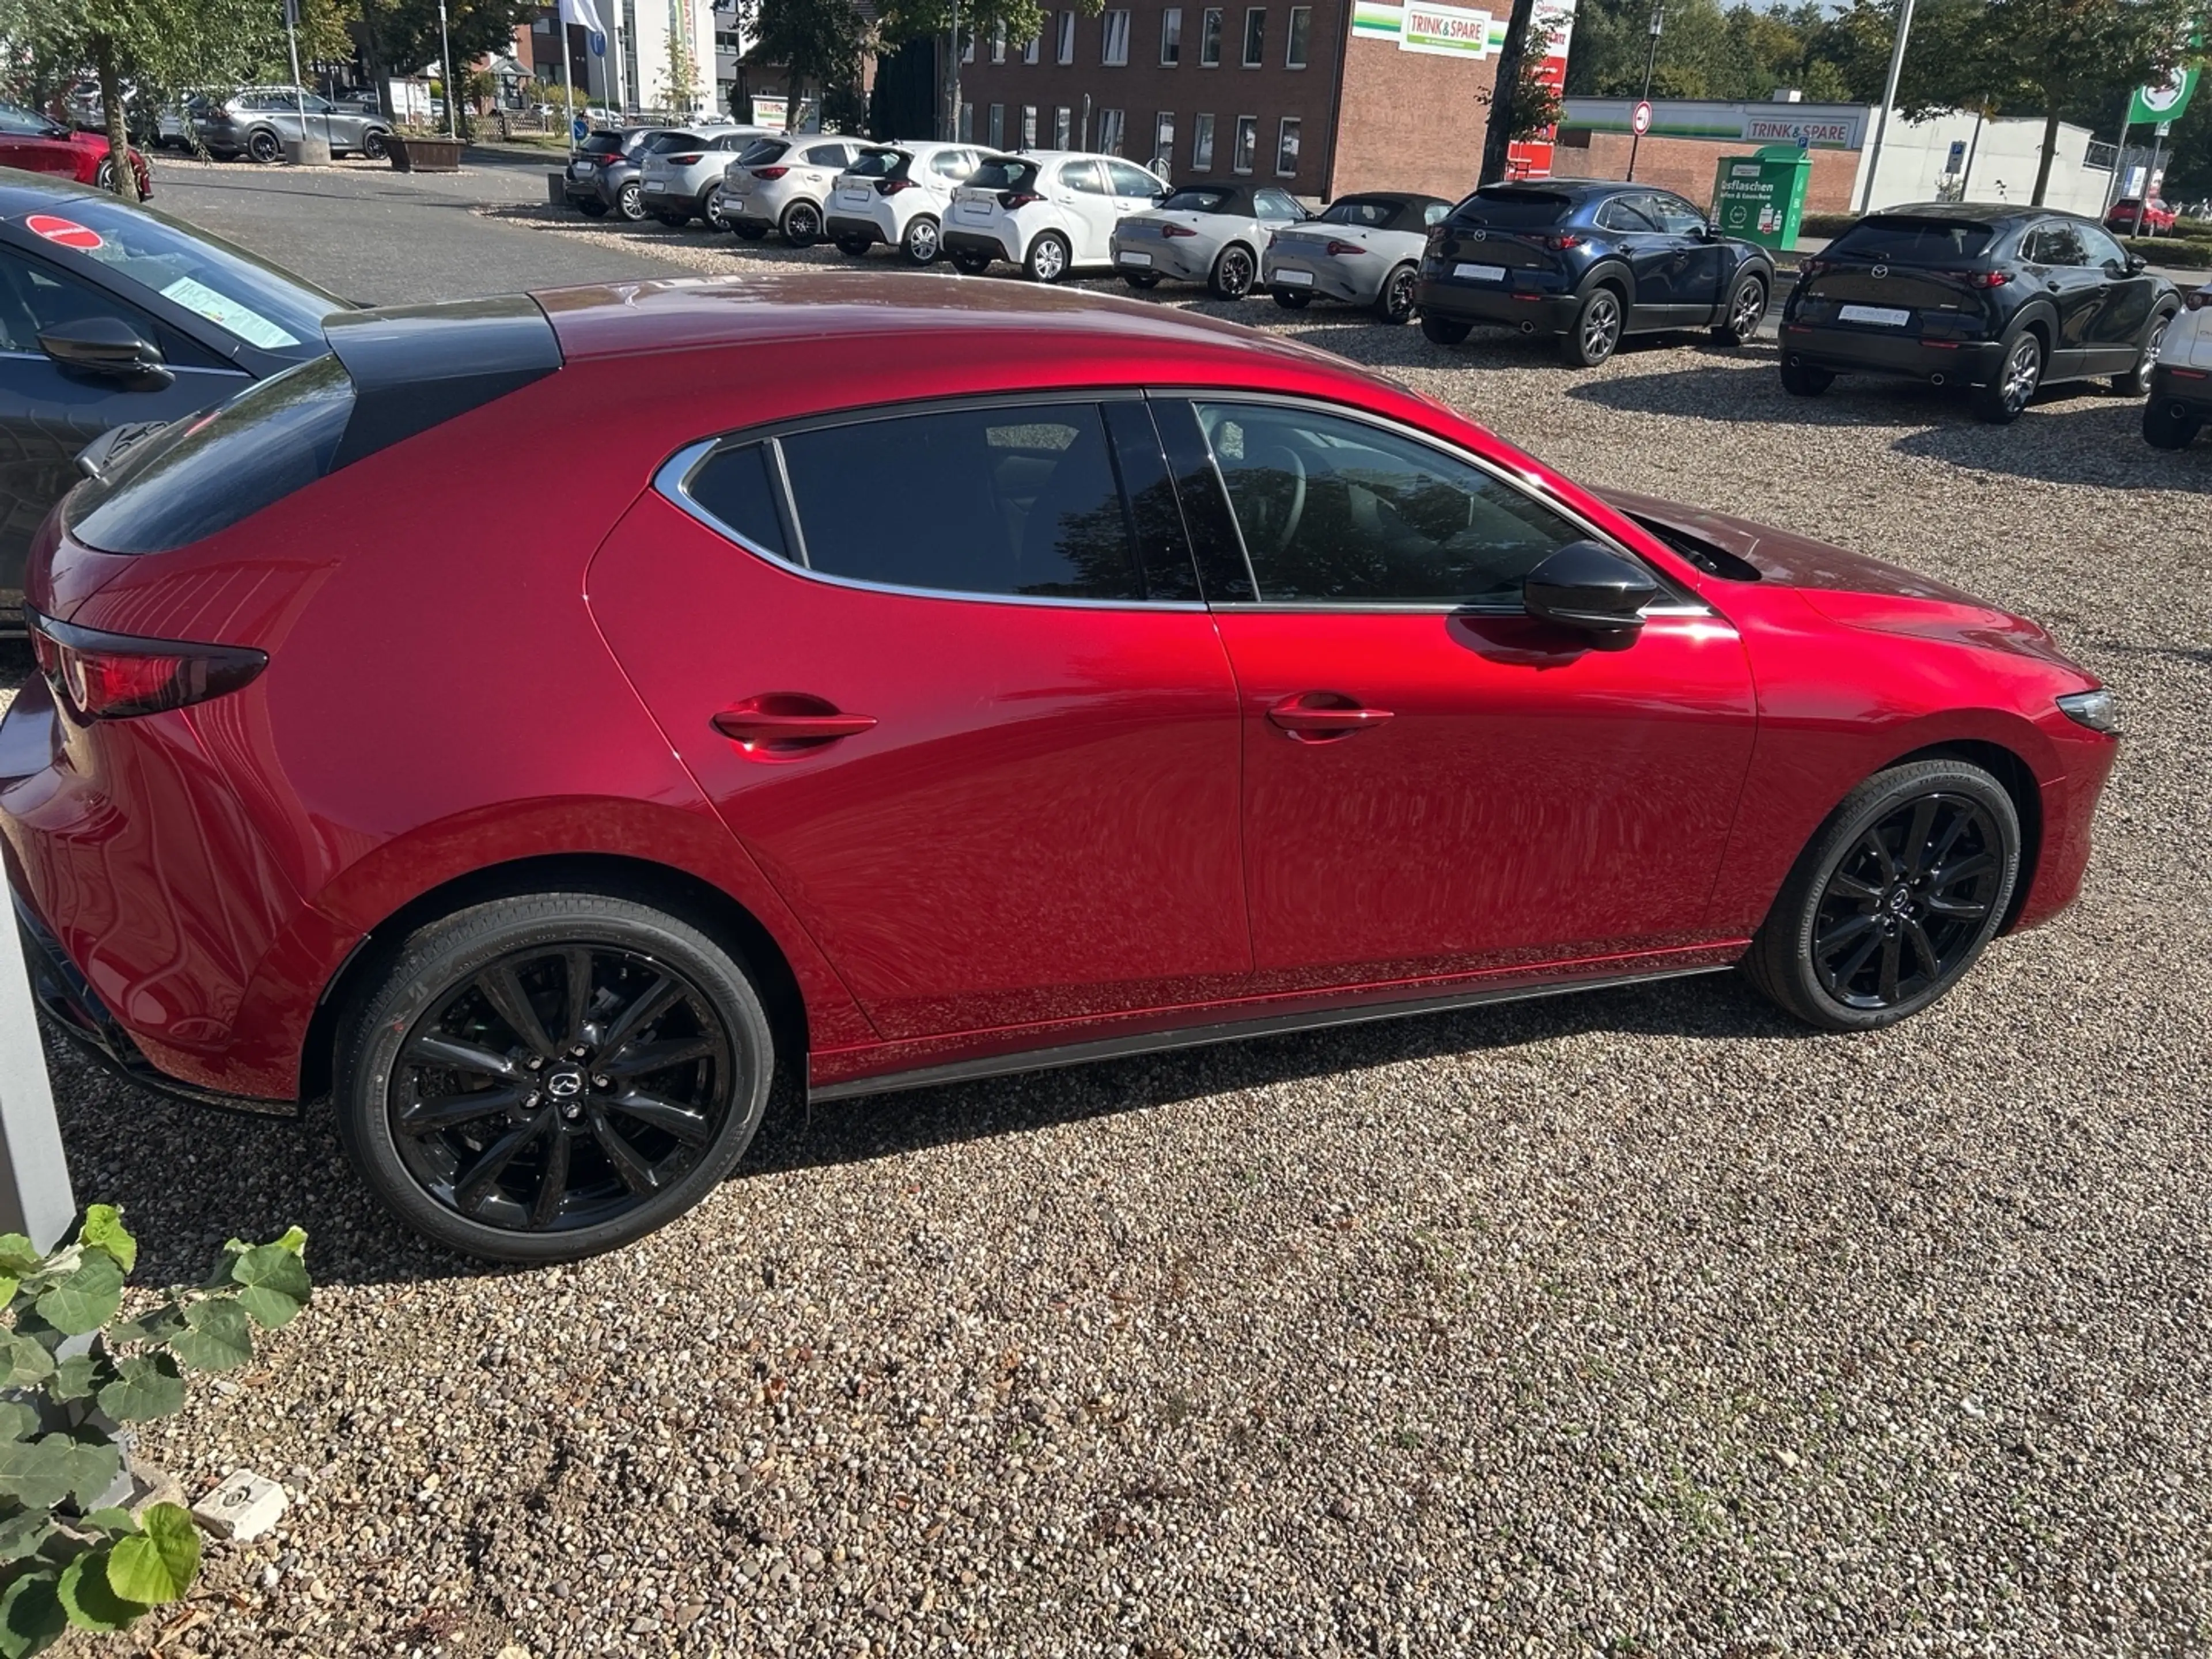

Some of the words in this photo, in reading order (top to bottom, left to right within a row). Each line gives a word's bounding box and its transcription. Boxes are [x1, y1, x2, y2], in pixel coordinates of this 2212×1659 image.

[1411, 15, 1444, 35] TRINK
[1442, 21, 1449, 36] &
[1450, 20, 1482, 40] SPARE
[1752, 123, 1792, 138] TRINK
[1793, 126, 1800, 138] &
[1802, 125, 1846, 140] SPARE
